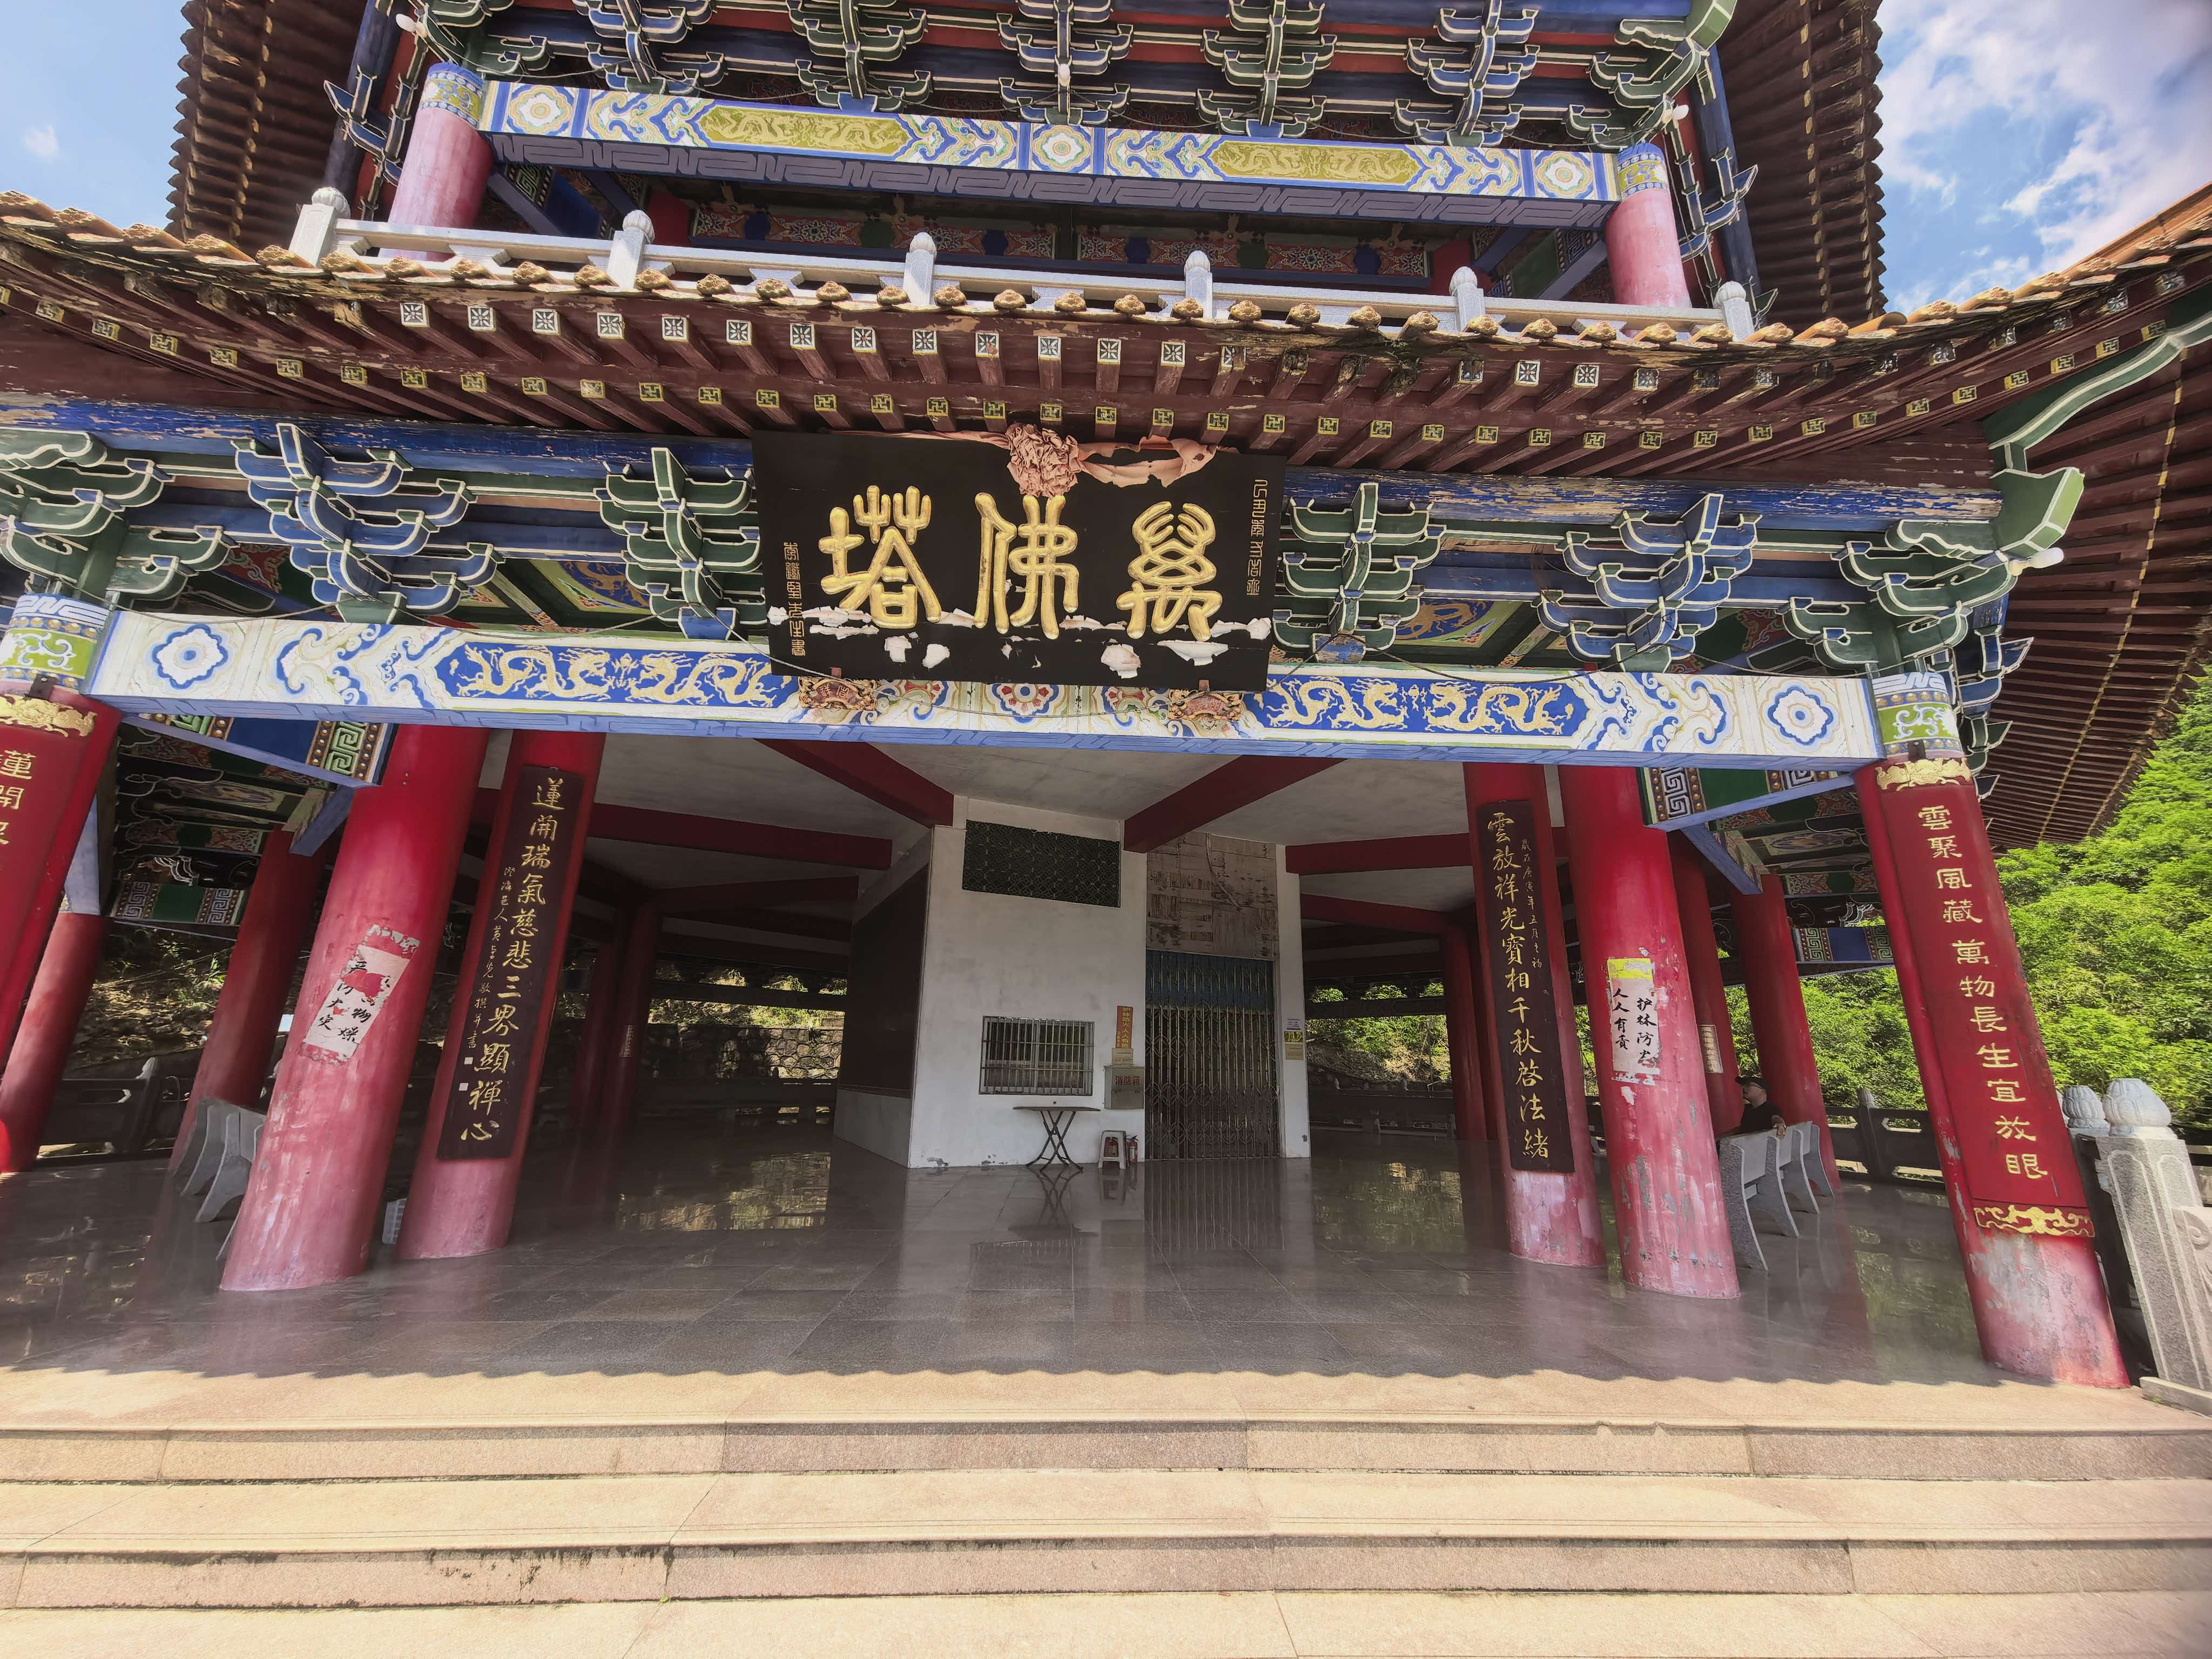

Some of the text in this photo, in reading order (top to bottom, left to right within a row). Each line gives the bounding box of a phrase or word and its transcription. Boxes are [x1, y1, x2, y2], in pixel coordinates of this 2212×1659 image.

[1613, 988, 1630, 1050] 人人有责
[1918, 805, 2048, 1179] 雲聚風藏萬物長生宜放眼
[1115, 1076, 1141, 1086] 消防箱
